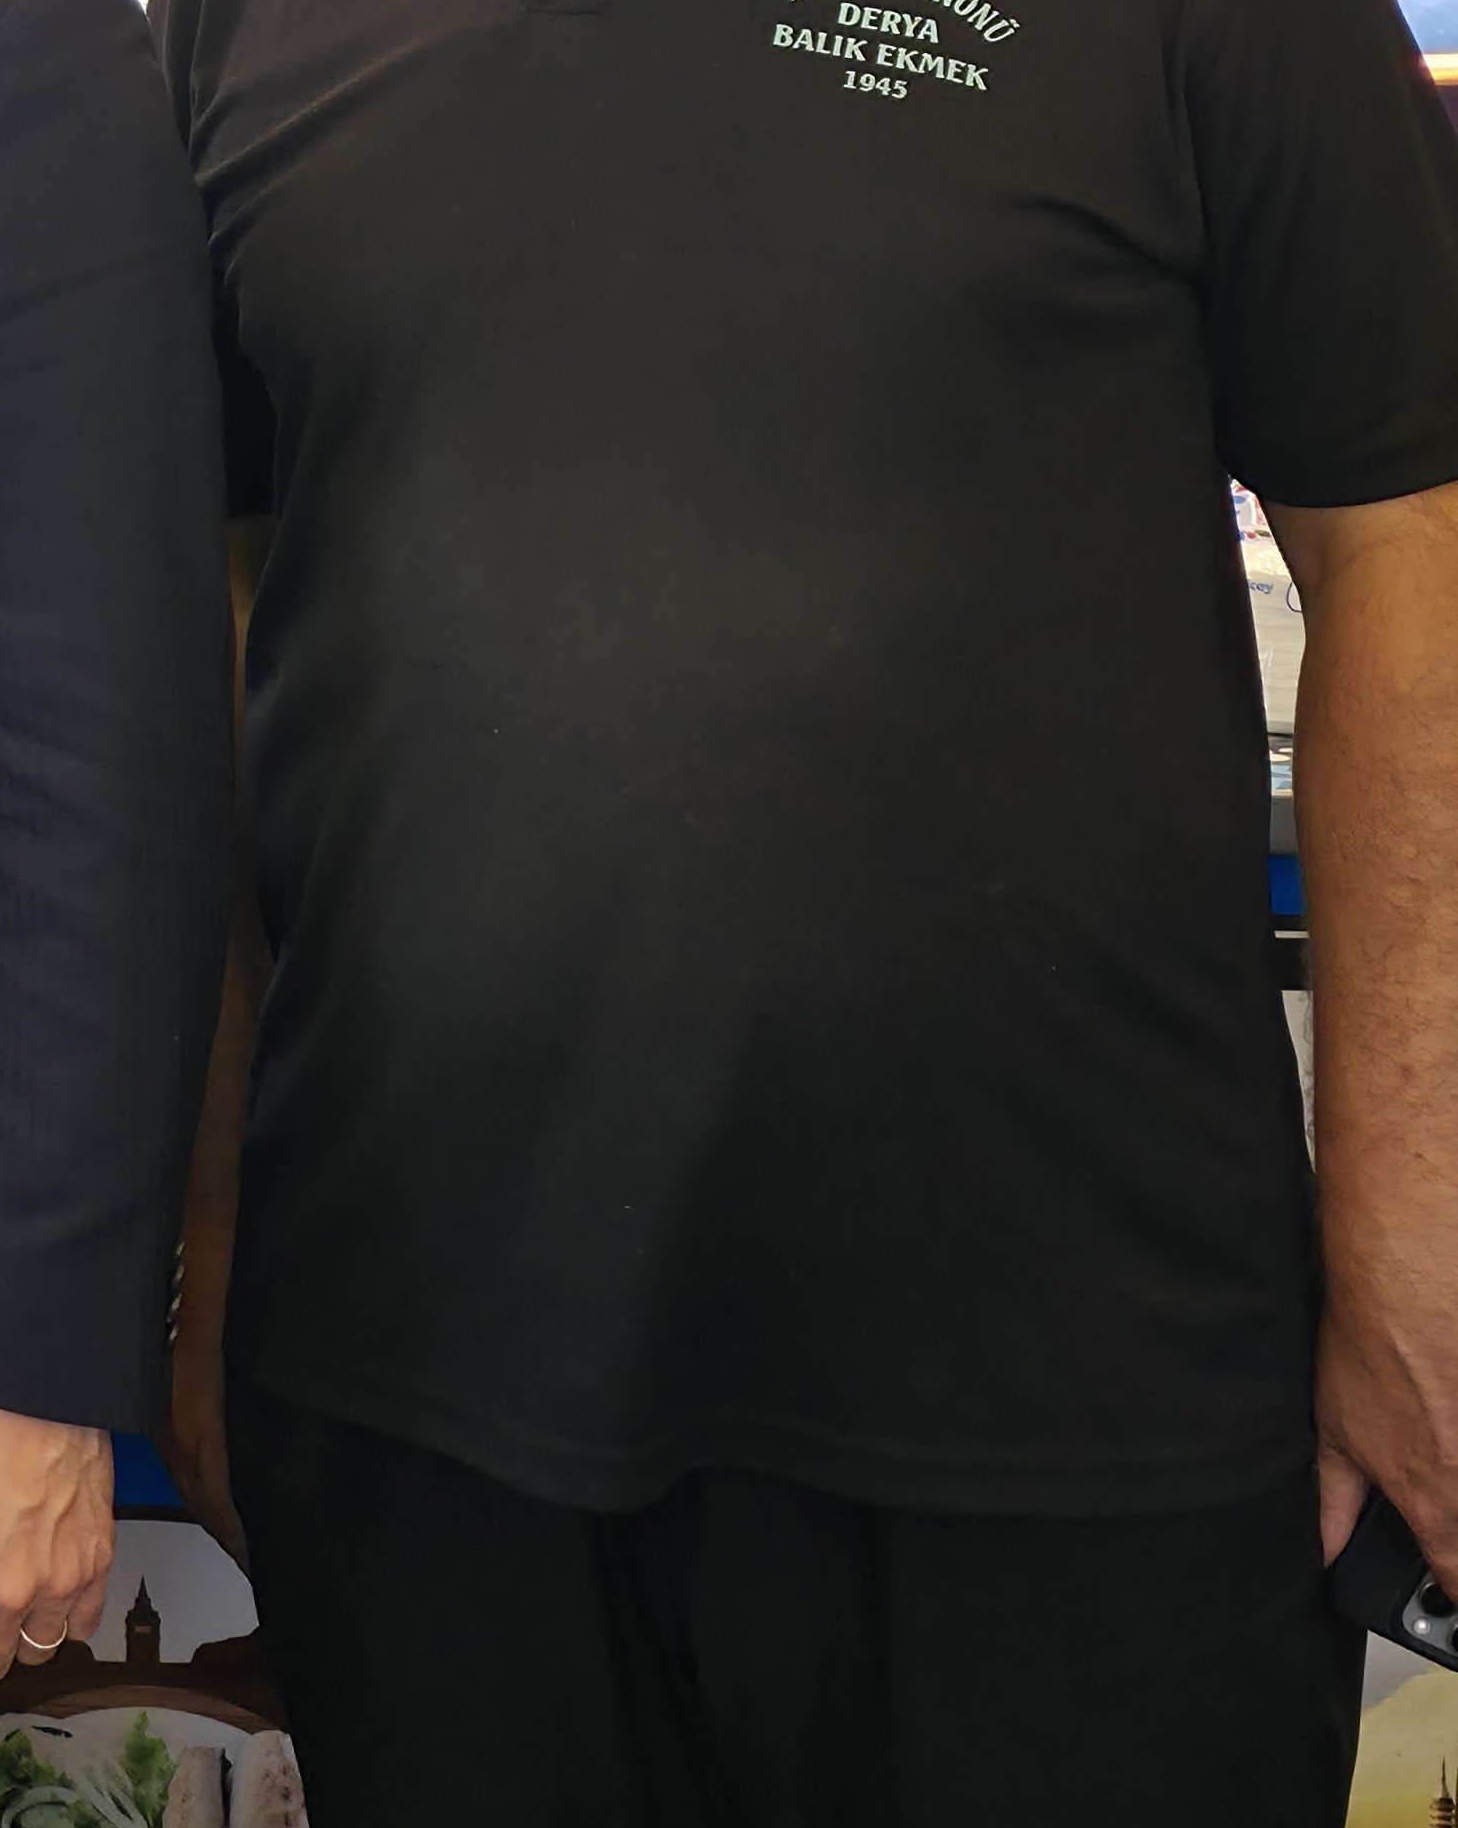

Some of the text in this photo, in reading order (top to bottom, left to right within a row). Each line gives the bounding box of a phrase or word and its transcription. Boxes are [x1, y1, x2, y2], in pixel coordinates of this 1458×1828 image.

[838, 2, 939, 43] DERYA
[773, 23, 989, 91] BALIK EKMEK
[843, 70, 908, 99] 1945
